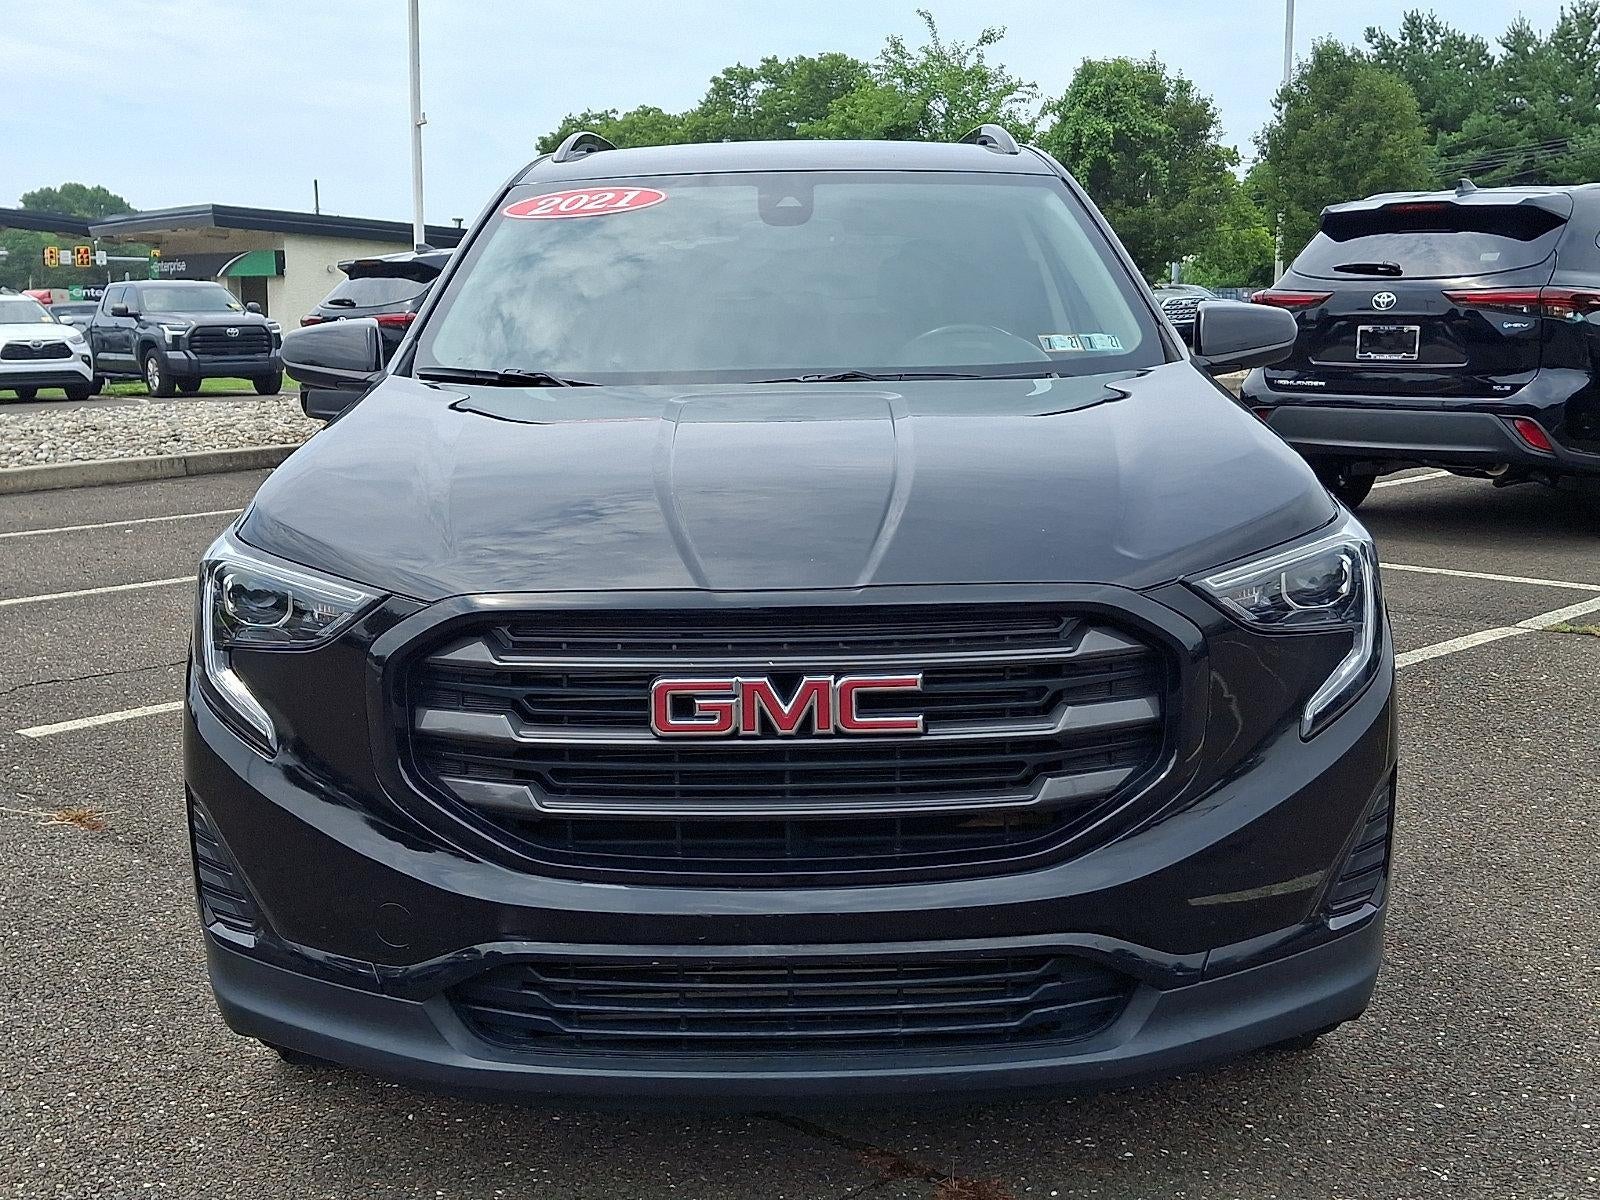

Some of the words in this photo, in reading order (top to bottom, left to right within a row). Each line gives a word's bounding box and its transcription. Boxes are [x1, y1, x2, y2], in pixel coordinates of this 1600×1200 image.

[526, 189, 642, 217] 2021
[151, 258, 187, 275] enterprise
[1273, 379, 1326, 387] HIGHLANDER
[650, 674, 925, 737] GMC
